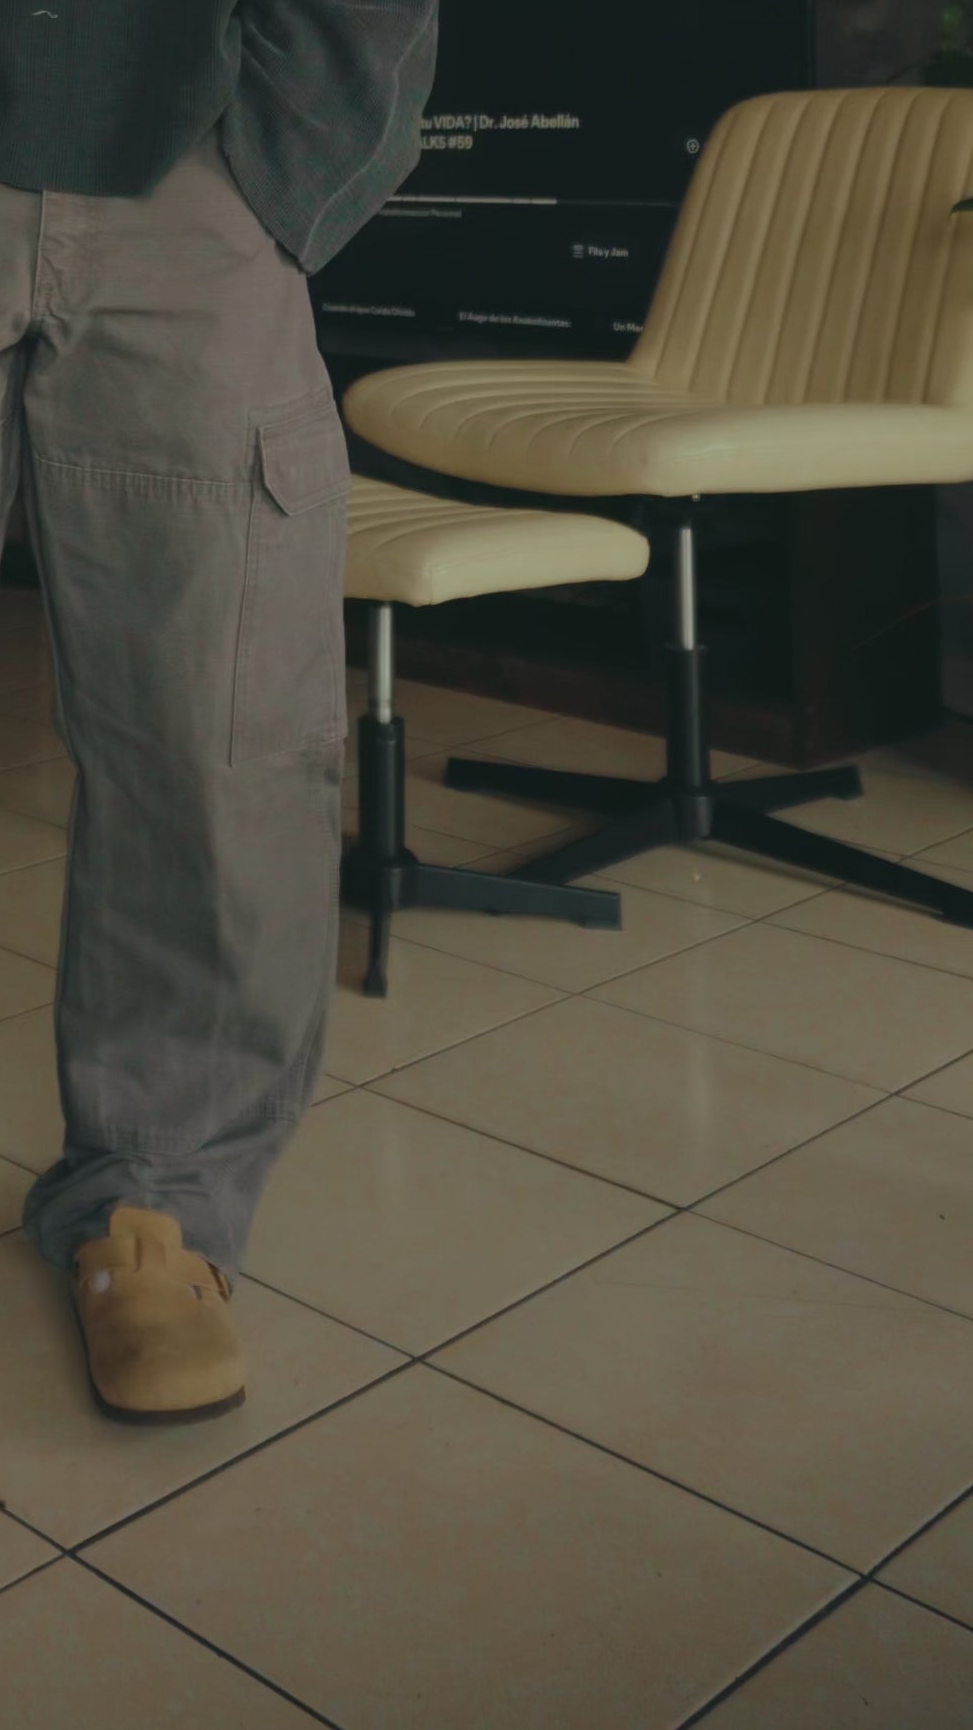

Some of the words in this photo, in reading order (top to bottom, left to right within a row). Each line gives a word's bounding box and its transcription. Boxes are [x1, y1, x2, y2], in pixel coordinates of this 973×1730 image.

[433, 114, 472, 130] VIDA?
[479, 114, 498, 130] Dr.
[499, 114, 529, 130] José
[530, 112, 580, 130] Abellán
[447, 135, 473, 150] #59
